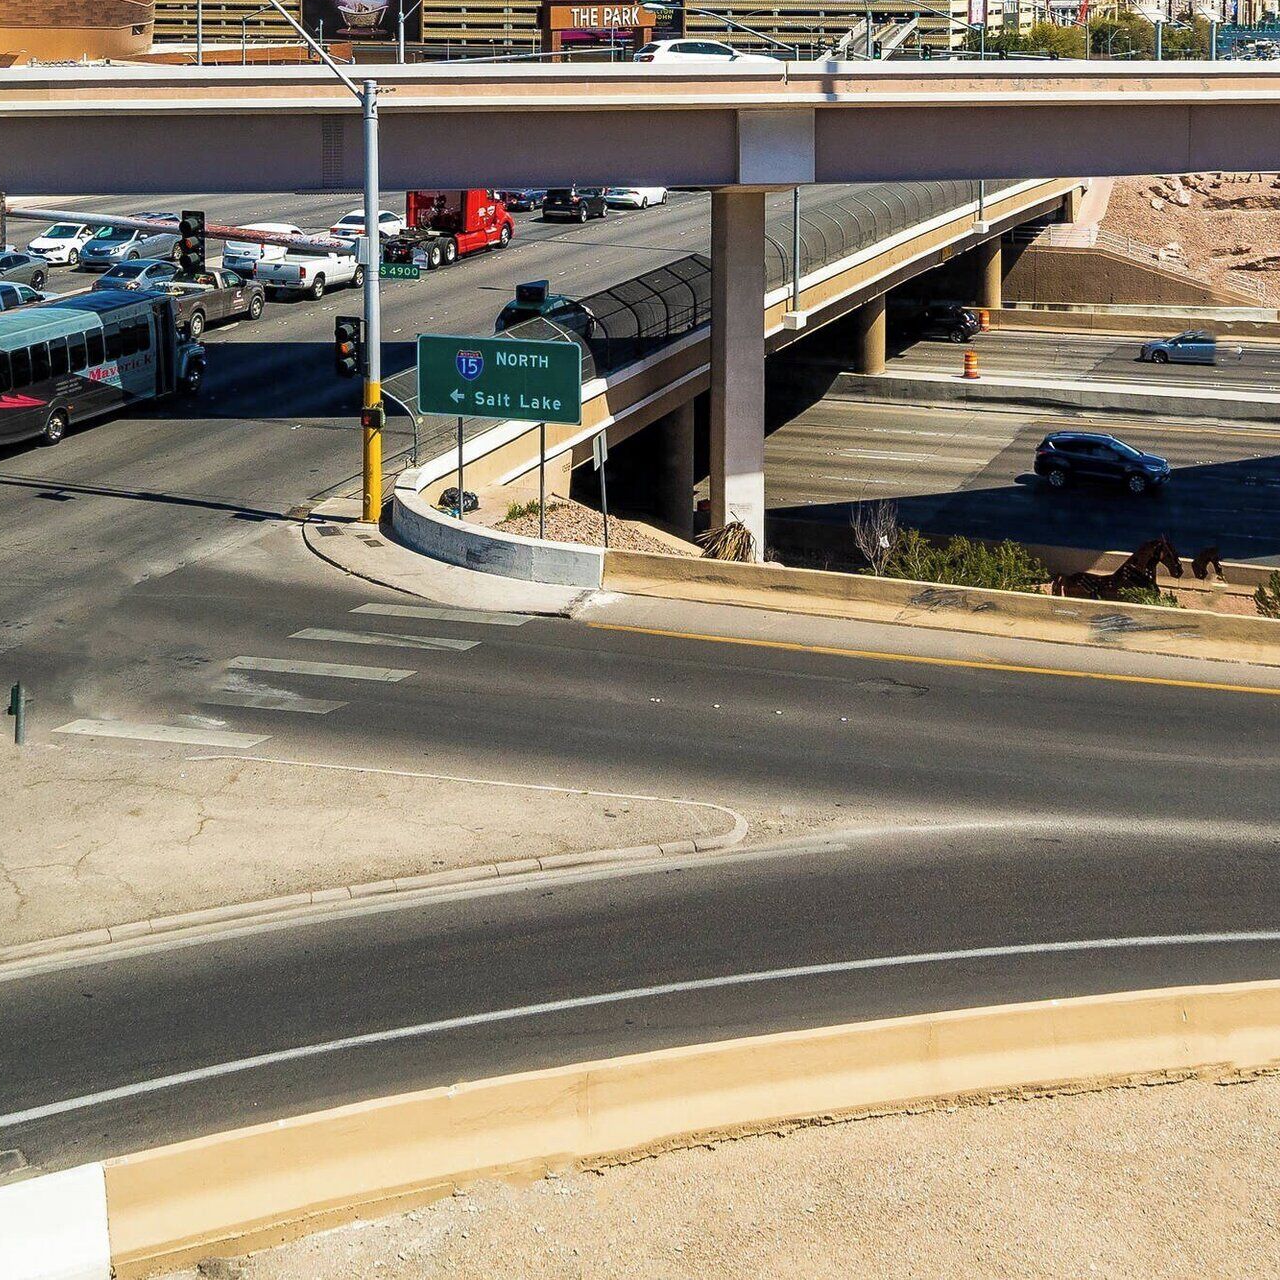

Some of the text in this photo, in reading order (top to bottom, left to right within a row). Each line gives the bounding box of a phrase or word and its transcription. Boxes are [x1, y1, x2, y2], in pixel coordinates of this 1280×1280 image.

[571, 7, 640, 27] THE PARK
[380, 266, 419, 276] S 4900
[461, 352, 549, 374] 15 NORTH
[475, 392, 562, 411] Salt Lake
